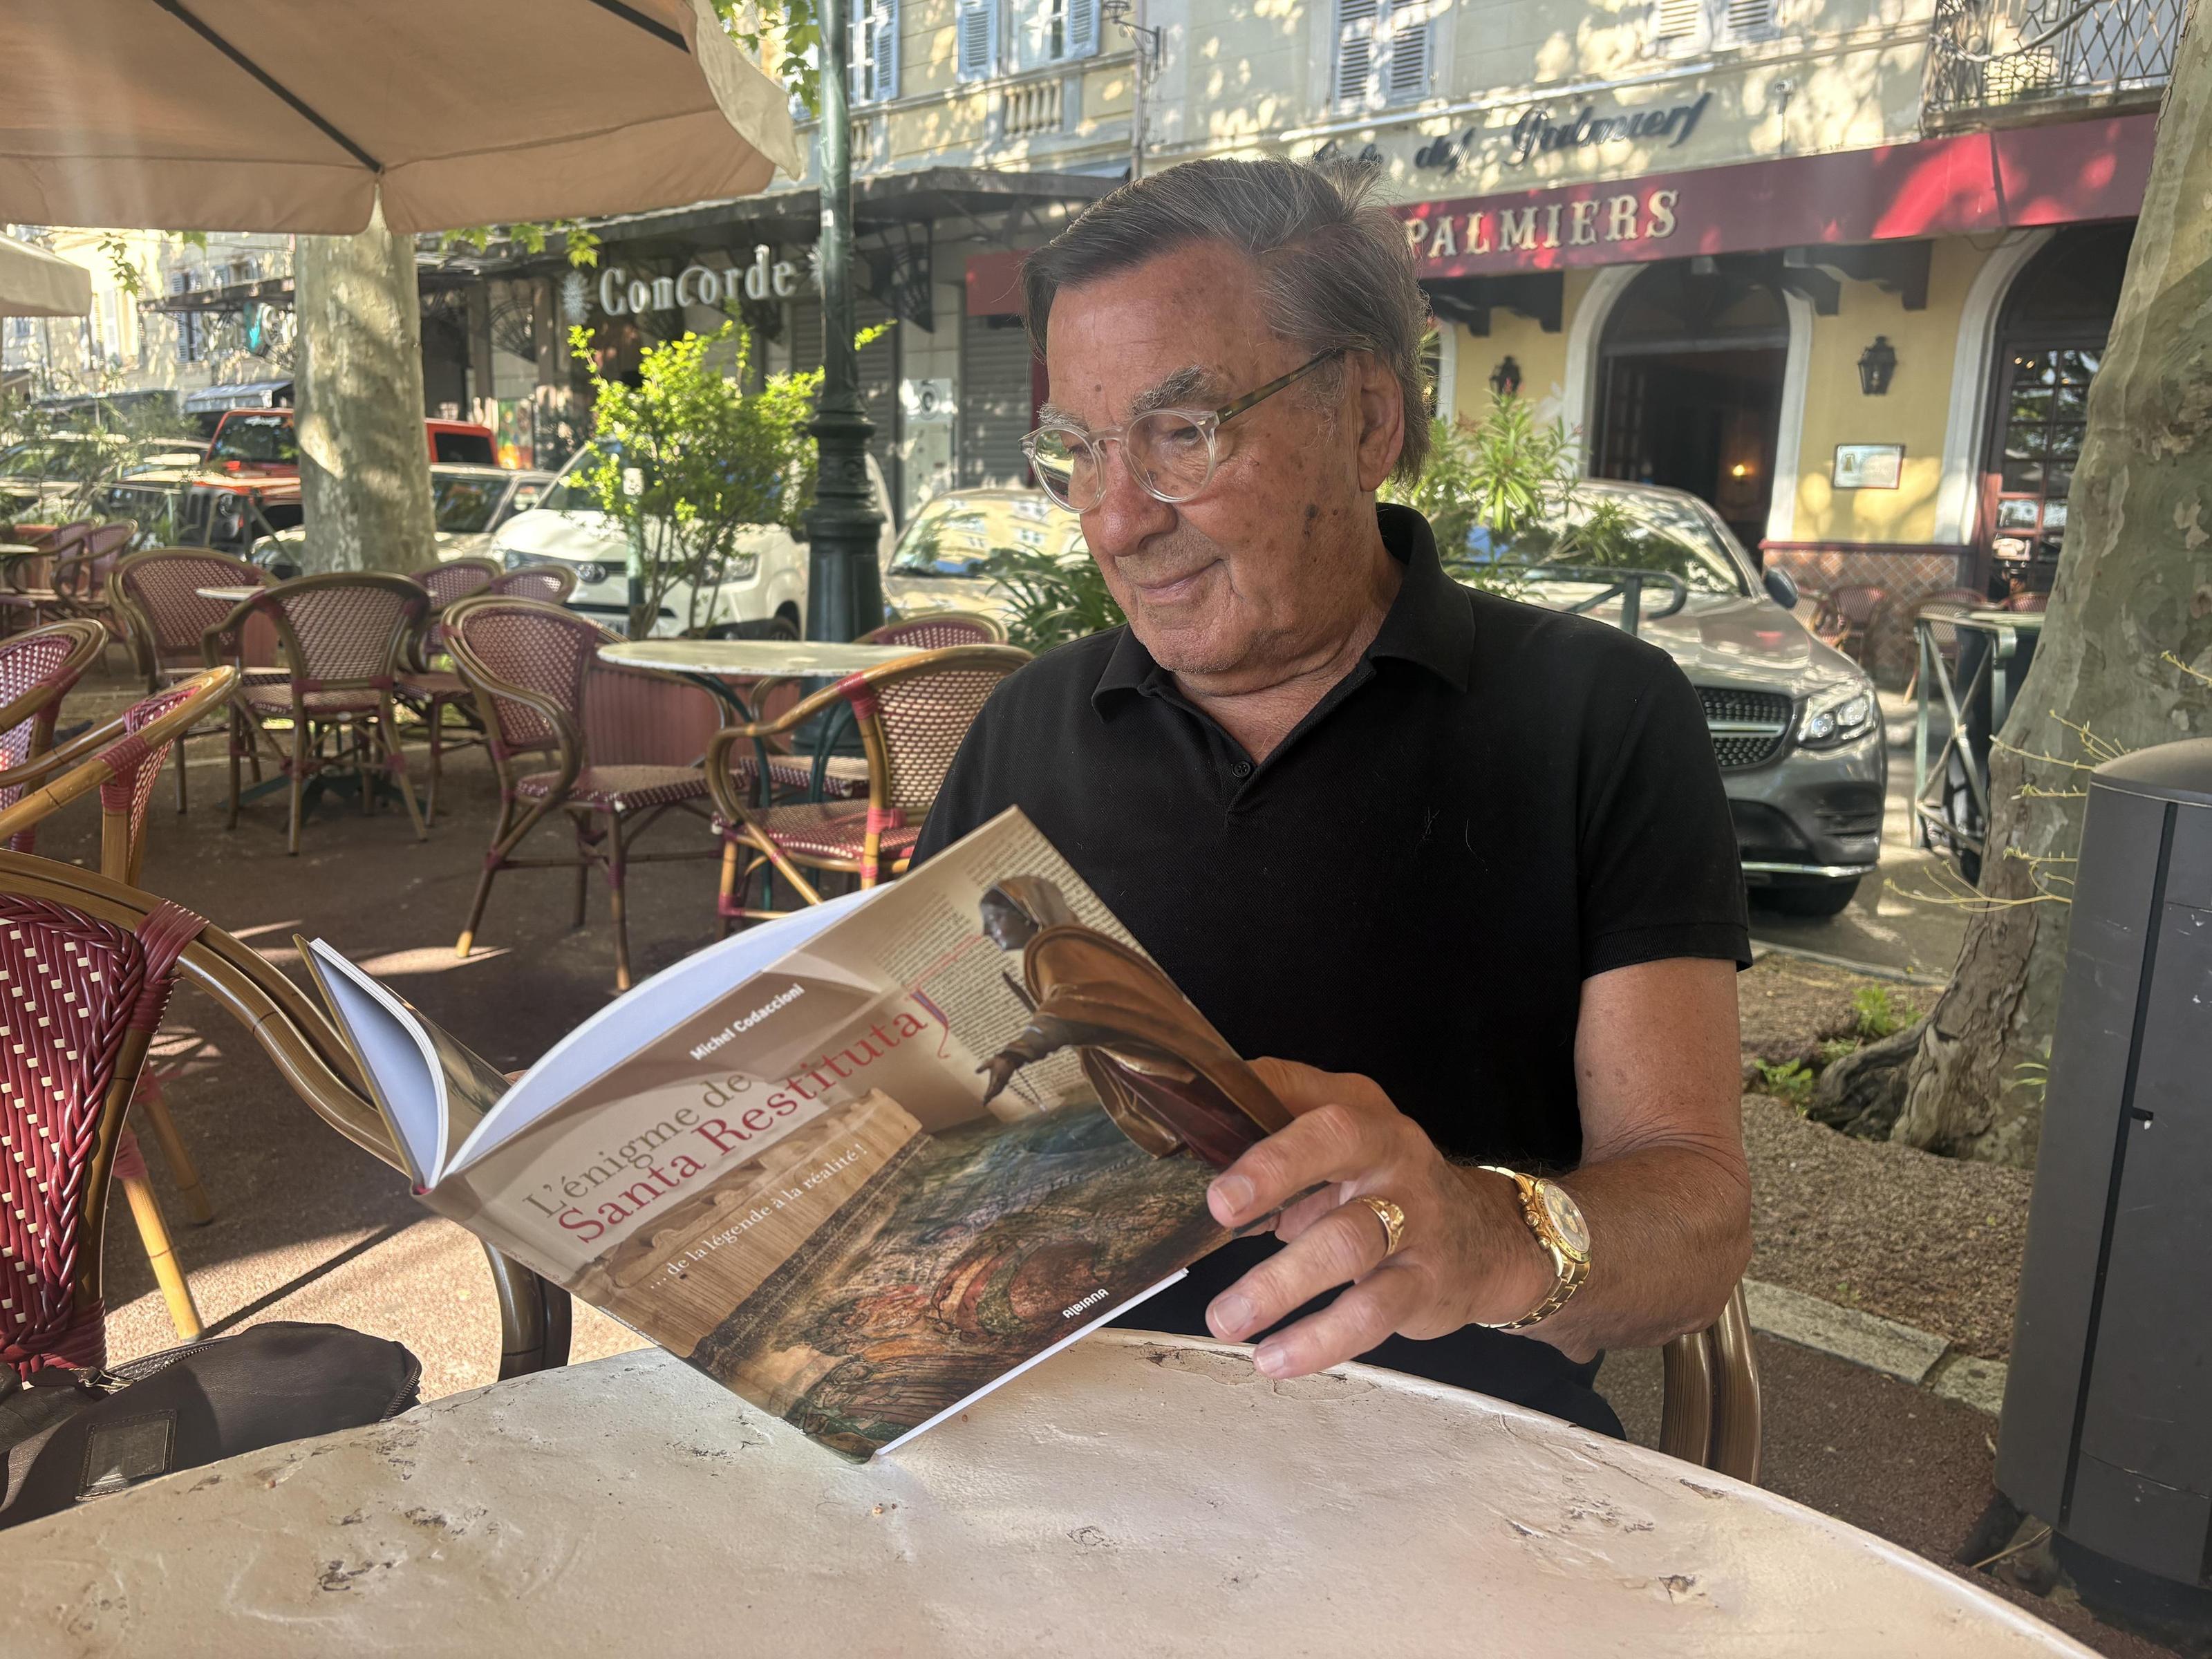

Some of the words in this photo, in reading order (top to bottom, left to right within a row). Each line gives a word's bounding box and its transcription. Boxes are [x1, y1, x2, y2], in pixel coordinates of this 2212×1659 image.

[1403, 188, 1680, 260] PALMIERS
[599, 244, 797, 317] Concorde
[689, 1027, 736, 1061] Michel
[733, 982, 805, 1032] Codaccioni
[522, 1107, 700, 1218] L'énigme
[700, 1074, 752, 1108] de
[559, 1154, 706, 1244] Santa
[691, 1011, 928, 1156] Restituta
[686, 1246, 709, 1262] la
[703, 1204, 772, 1251] légende
[770, 1197, 786, 1210] à
[780, 1182, 804, 1200] la
